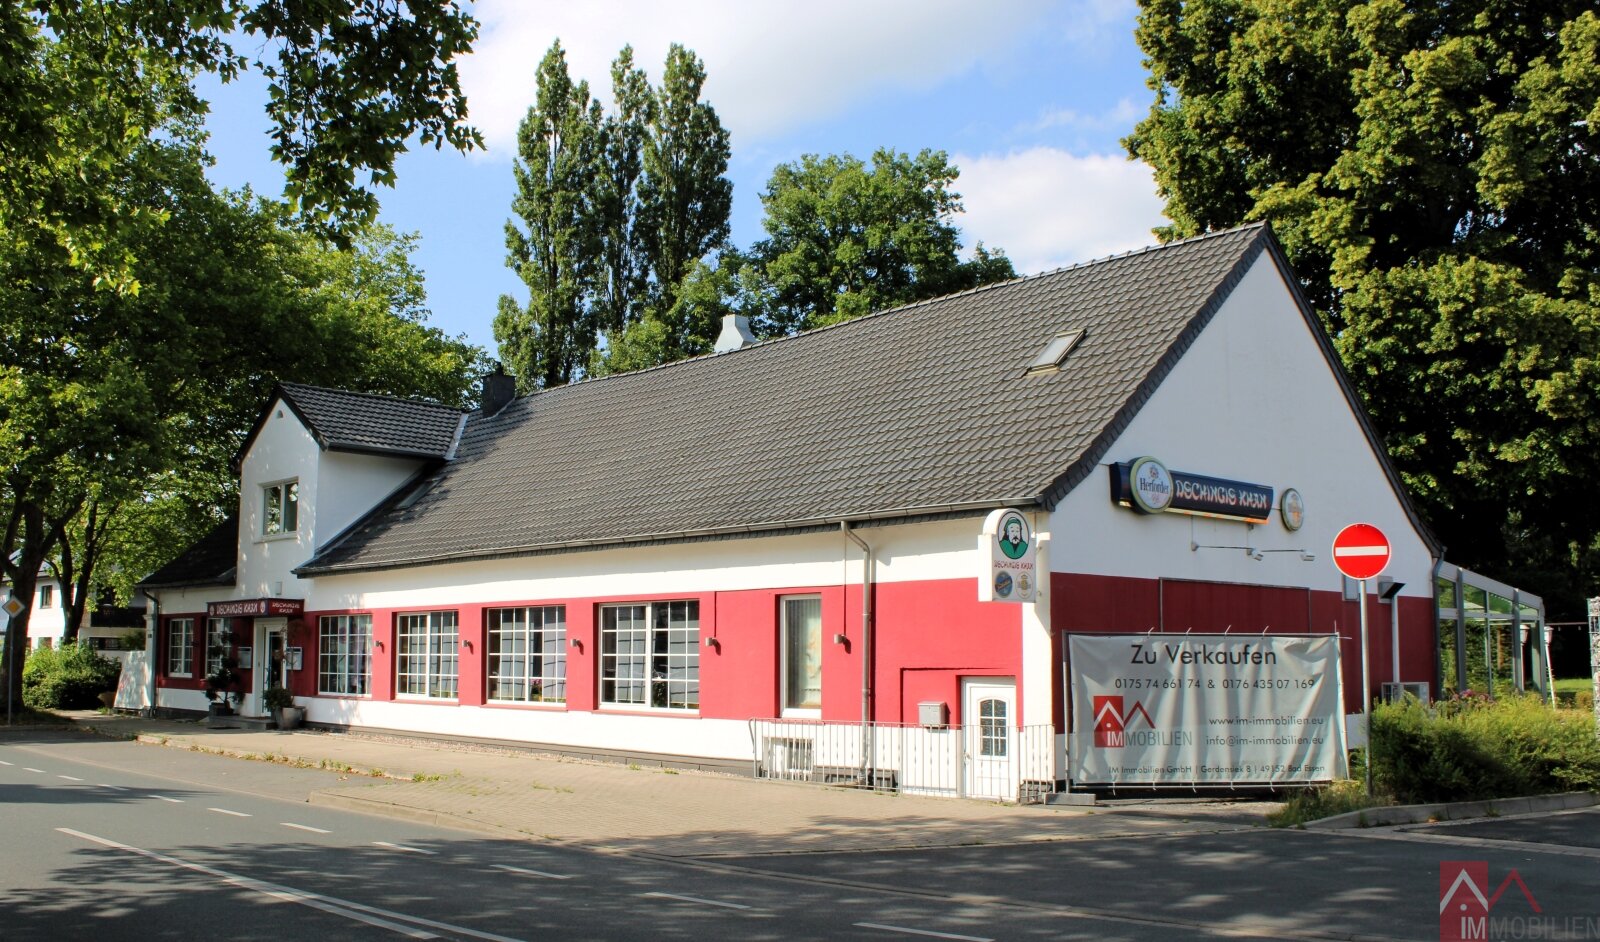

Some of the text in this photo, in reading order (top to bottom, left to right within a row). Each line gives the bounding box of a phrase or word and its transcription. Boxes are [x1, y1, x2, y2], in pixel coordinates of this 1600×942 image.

[1139, 477, 1169, 494] Herforder
[1175, 479, 1237, 506] DSCHINGIS
[1238, 489, 1268, 510] KHAN
[1131, 644, 1277, 665] Zu Verkaufen
[1115, 678, 1315, 689] 0175 74 661 74 & 0176 435 07 169
[1208, 716, 1324, 726] www.im-immobilien.eu
[1206, 735, 1324, 747] info@im-immobilien.eu
[1121, 764, 1165, 774] Immobilien
[1166, 764, 1192, 773] GmbH
[1287, 764, 1302, 772] Bad
[1304, 764, 1325, 773] Essen
